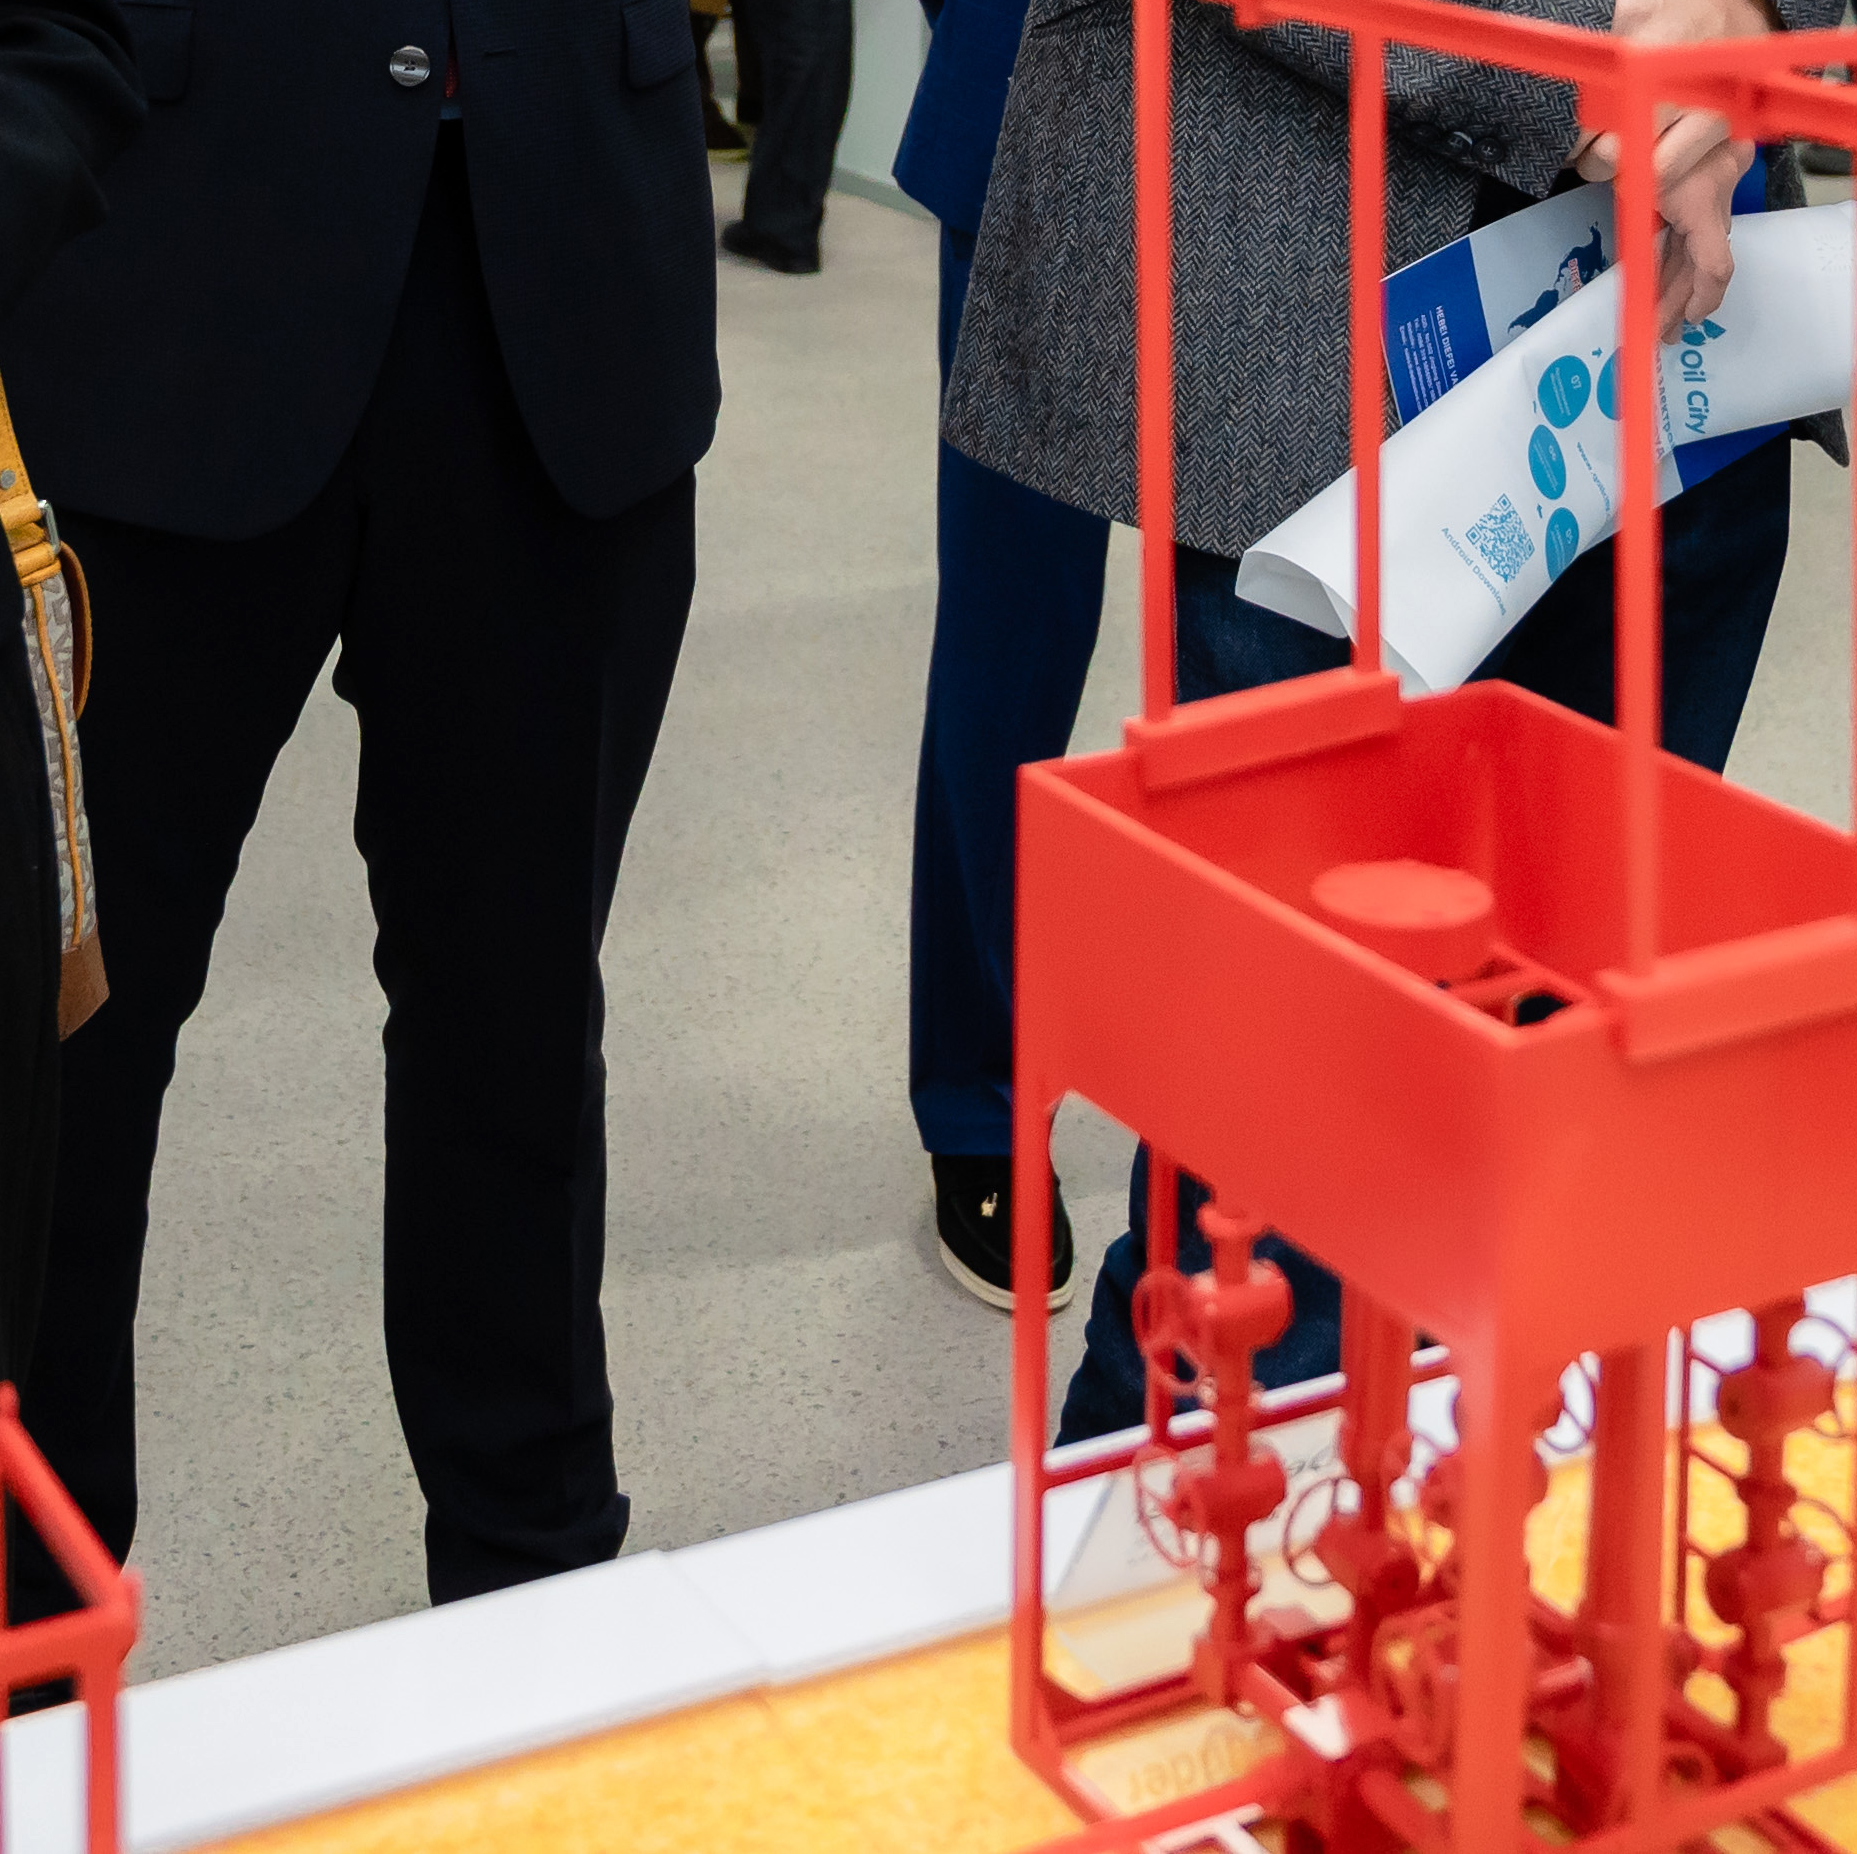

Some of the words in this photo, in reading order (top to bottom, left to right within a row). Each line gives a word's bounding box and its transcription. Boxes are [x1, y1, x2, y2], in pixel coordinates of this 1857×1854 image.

[1436, 305, 1448, 336] HEBEI
[1442, 337, 1456, 370] DIEFEI
[1680, 349, 1706, 382] Oil
[1685, 390, 1709, 434] City
